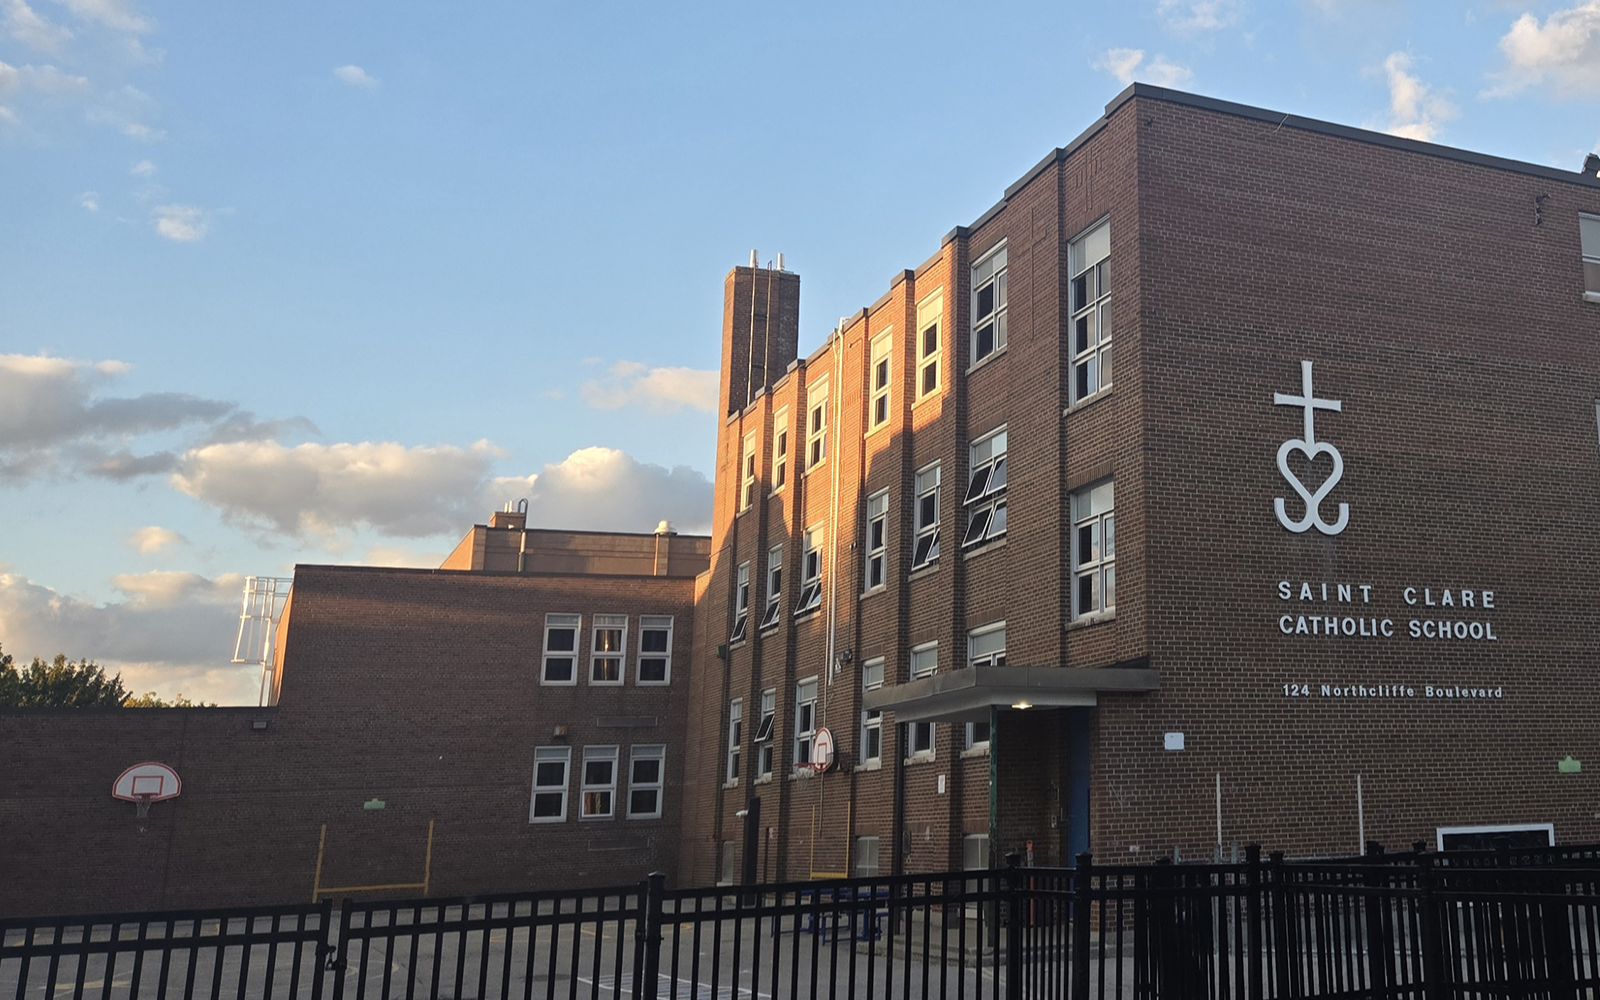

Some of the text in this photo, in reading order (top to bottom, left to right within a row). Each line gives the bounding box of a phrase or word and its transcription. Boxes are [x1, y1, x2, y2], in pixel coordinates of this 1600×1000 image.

[1278, 581, 1495, 609] SAINT CLARE
[1279, 615, 1497, 640] CATHOLIC SCHOOL
[1283, 684, 1502, 698] 124 Northcliffe Boulevard
